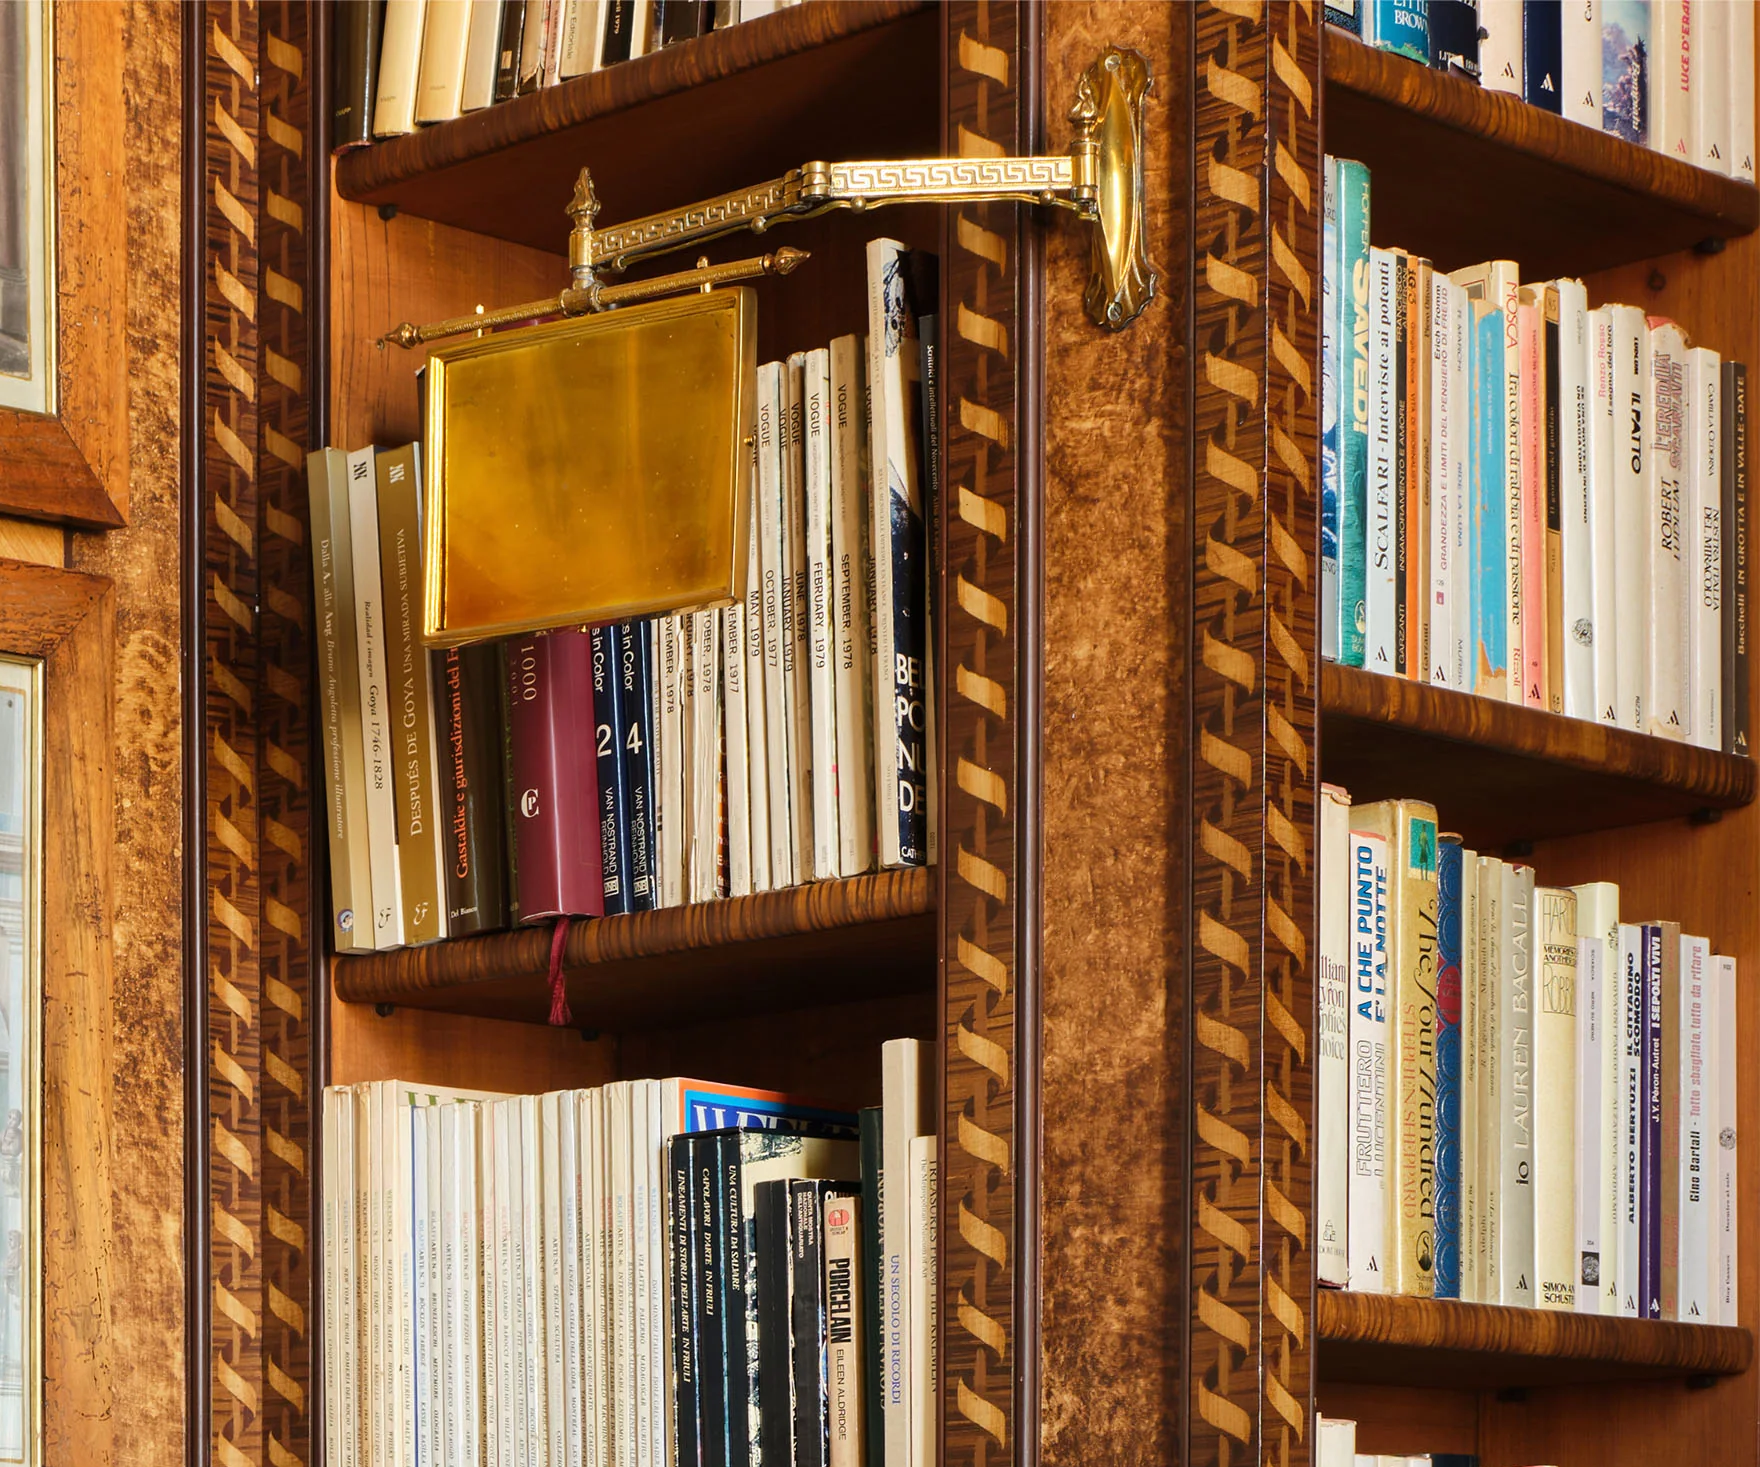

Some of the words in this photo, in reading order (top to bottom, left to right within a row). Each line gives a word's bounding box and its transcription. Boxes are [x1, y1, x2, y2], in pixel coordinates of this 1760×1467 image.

[1377, 262, 1391, 327] potenti
[1433, 285, 1442, 325] Fromm
[1506, 281, 1519, 349] MOSCA
[1353, 258, 1370, 435] SAVED!
[760, 403, 772, 449] VOGUE
[790, 402, 801, 448] VOGUE
[809, 392, 821, 438] VOGUE
[837, 383, 848, 429] VOGUE
[1377, 354, 1390, 443] Interviste
[1631, 407, 1642, 475] PATTO
[1374, 452, 1390, 571] SCALFARI
[1398, 460, 1407, 572] INNAMORAMENTO
[1509, 467, 1521, 521] rabbia
[1660, 476, 1674, 553] ROBERT
[1440, 498, 1448, 571] GRANDEZZA
[812, 561, 825, 632] FEBRUARY,
[840, 553, 852, 632] SEPTEMBER,
[1508, 556, 1520, 625] passione
[1703, 536, 1714, 608] MIRACOLO
[767, 636, 778, 667] 1977
[796, 611, 807, 642] 1978
[815, 637, 826, 668] 1979
[842, 638, 854, 669] 1978
[1398, 603, 1407, 665] GARZANTI
[594, 652, 607, 693] Color
[621, 651, 635, 692] Color
[703, 662, 713, 693] 1978
[729, 663, 740, 694] 1977
[367, 684, 380, 716] Goya
[371, 721, 384, 790] 1746-1828
[596, 724, 613, 758] 2
[625, 722, 644, 755] 4
[607, 813, 618, 873] NOSTRAND
[637, 812, 647, 873] NOSTRAND
[1357, 844, 1374, 935] PUNTO
[1357, 941, 1373, 994] CHE
[1512, 892, 1530, 1013] BACALL
[1357, 1001, 1373, 1022] A
[1356, 1040, 1373, 1177] FRUTTERO
[1512, 1027, 1529, 1150] LAUREN
[1628, 1067, 1637, 1145] BERTUZZI
[729, 1164, 739, 1185] UNA
[1402, 1109, 1418, 1218] SHEPPARD
[1628, 1150, 1636, 1224] ALBERTO
[1689, 1176, 1700, 1203] Gino
[677, 1169, 689, 1232] LINEAMENTI
[702, 1167, 713, 1227] CAPOLAVORI
[730, 1187, 740, 1234] CULTURA
[680, 1246, 689, 1282] STORIA
[890, 1253, 901, 1274] UN
[828, 1257, 852, 1345] PORCELAIN
[890, 1277, 902, 1329] SECOLO
[683, 1348, 692, 1384] FRIULI
[836, 1348, 846, 1386] EILEEN
[891, 1349, 902, 1406] RICORDI
[837, 1387, 849, 1442] ALDRIDGE
